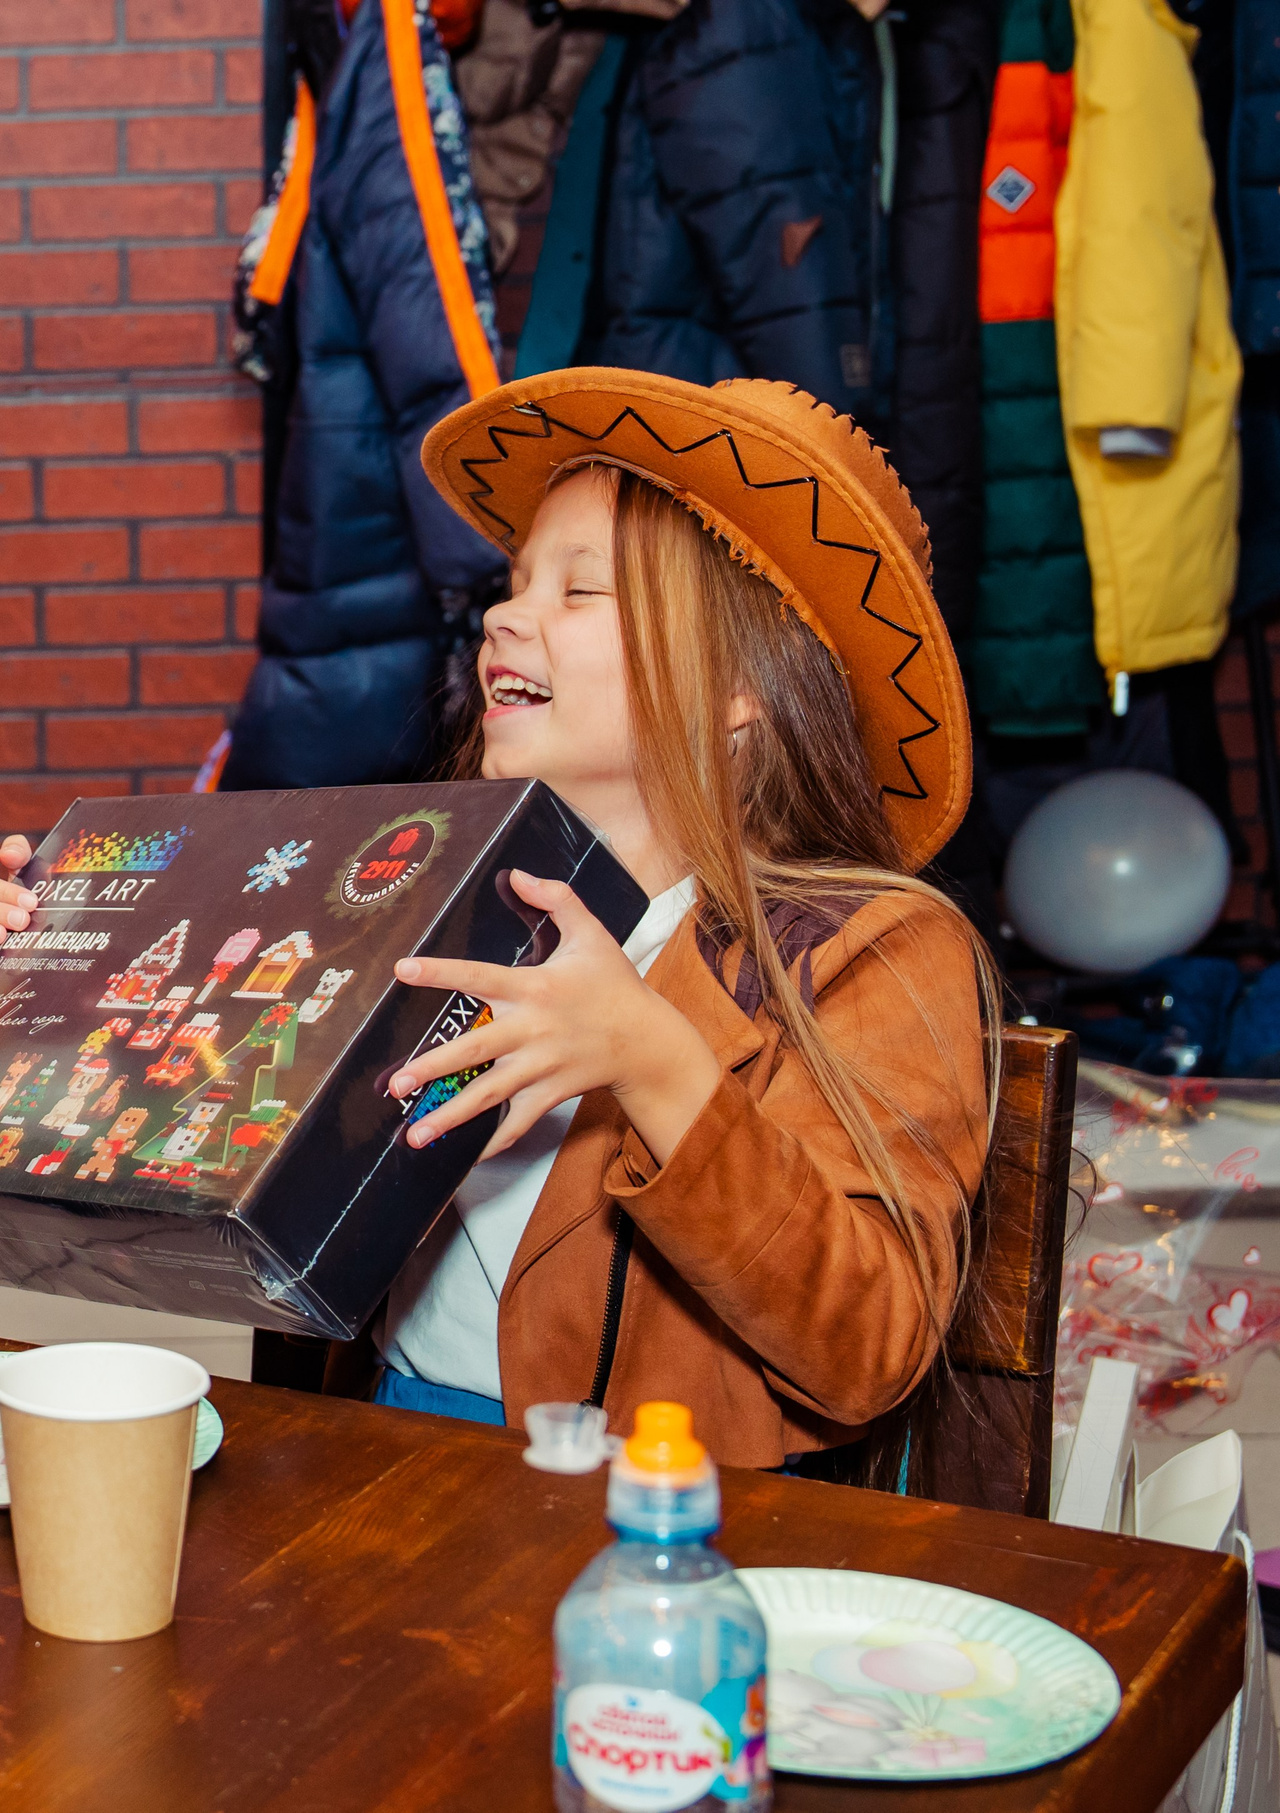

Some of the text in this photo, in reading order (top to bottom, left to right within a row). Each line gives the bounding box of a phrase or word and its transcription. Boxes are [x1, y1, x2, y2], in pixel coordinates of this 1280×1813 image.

[359, 860, 407, 879] 2911
[29, 878, 156, 901] PIXEL ART
[33, 931, 112, 953] КАЛЕНДАРЬ
[43, 958, 96, 972] НАСТРОЕНИЕ
[28, 1014, 67, 1035] года
[430, 994, 479, 1044] IXEL
